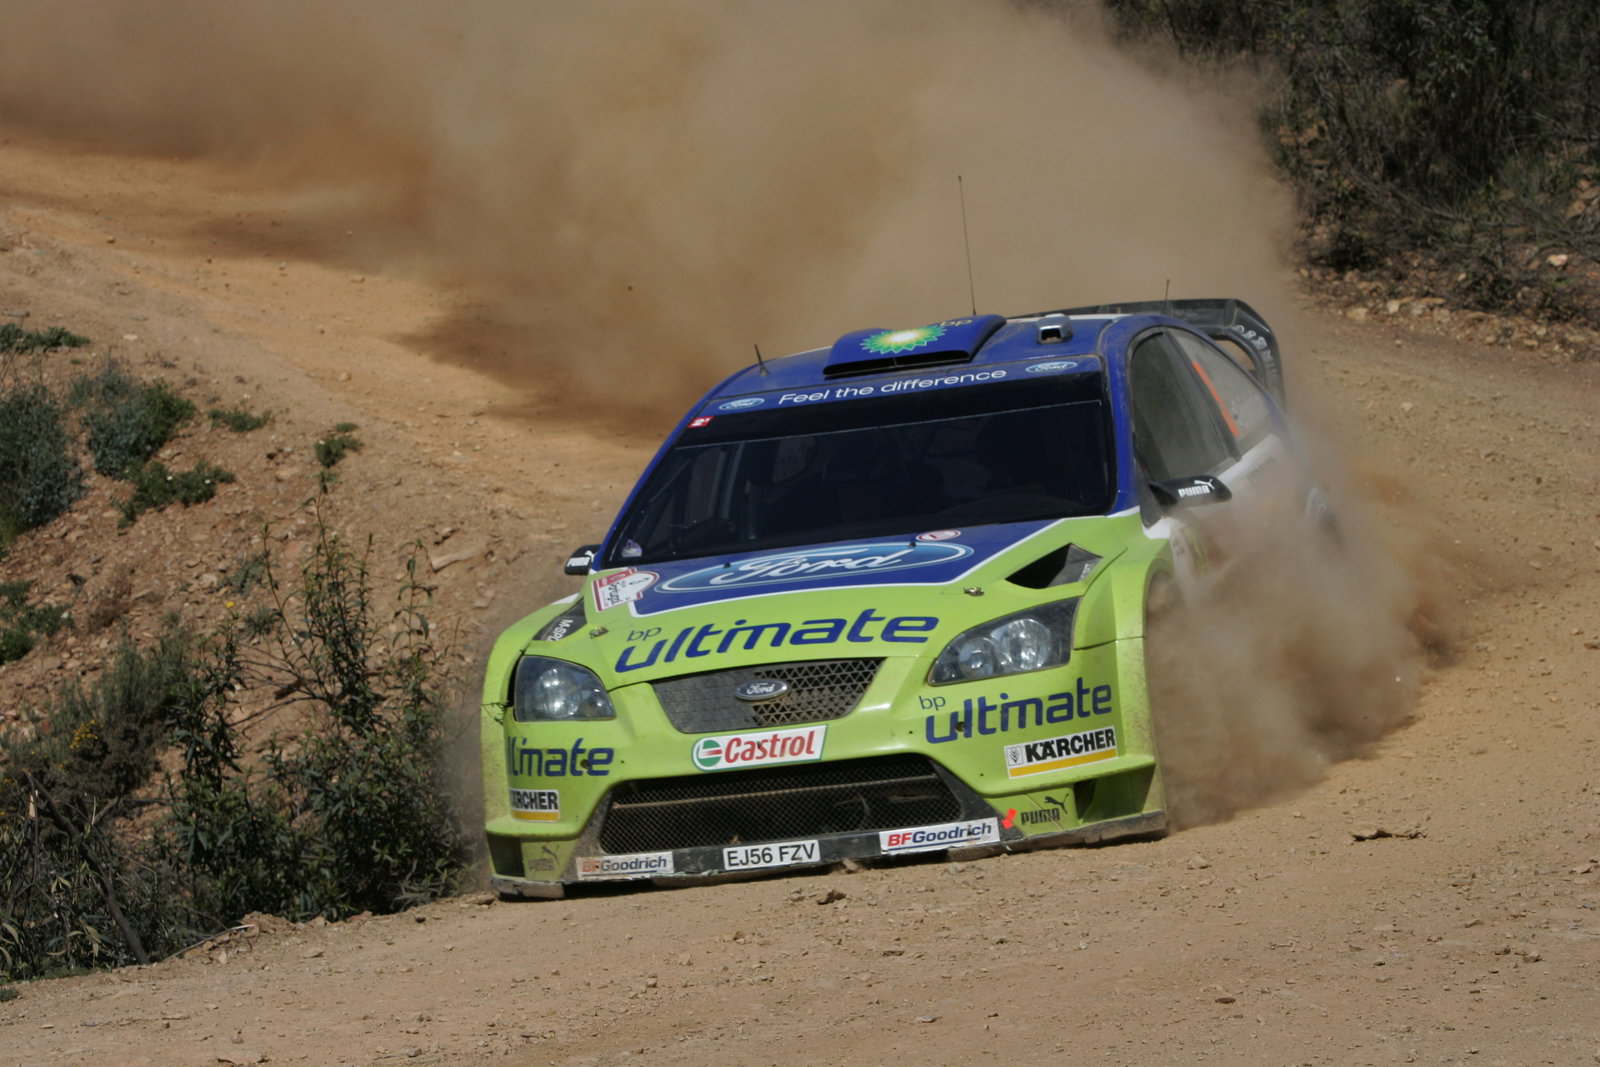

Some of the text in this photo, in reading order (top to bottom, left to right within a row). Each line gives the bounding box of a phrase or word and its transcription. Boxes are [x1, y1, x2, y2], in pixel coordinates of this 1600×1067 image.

[778, 369, 1007, 405] Feel the difference
[1177, 485, 1211, 498] PUMA
[709, 548, 914, 585] Ford
[614, 608, 940, 673] ultimate
[627, 627, 662, 642] bp
[746, 682, 776, 695] Ford
[918, 695, 947, 711] bp
[925, 677, 1113, 744] ultimate
[725, 730, 815, 763] Castrol
[1026, 728, 1116, 763] KÄRCHER
[1020, 807, 1061, 825] PUMA
[887, 823, 992, 847] BFGoodrich
[727, 843, 815, 867] EJ56 FZV
